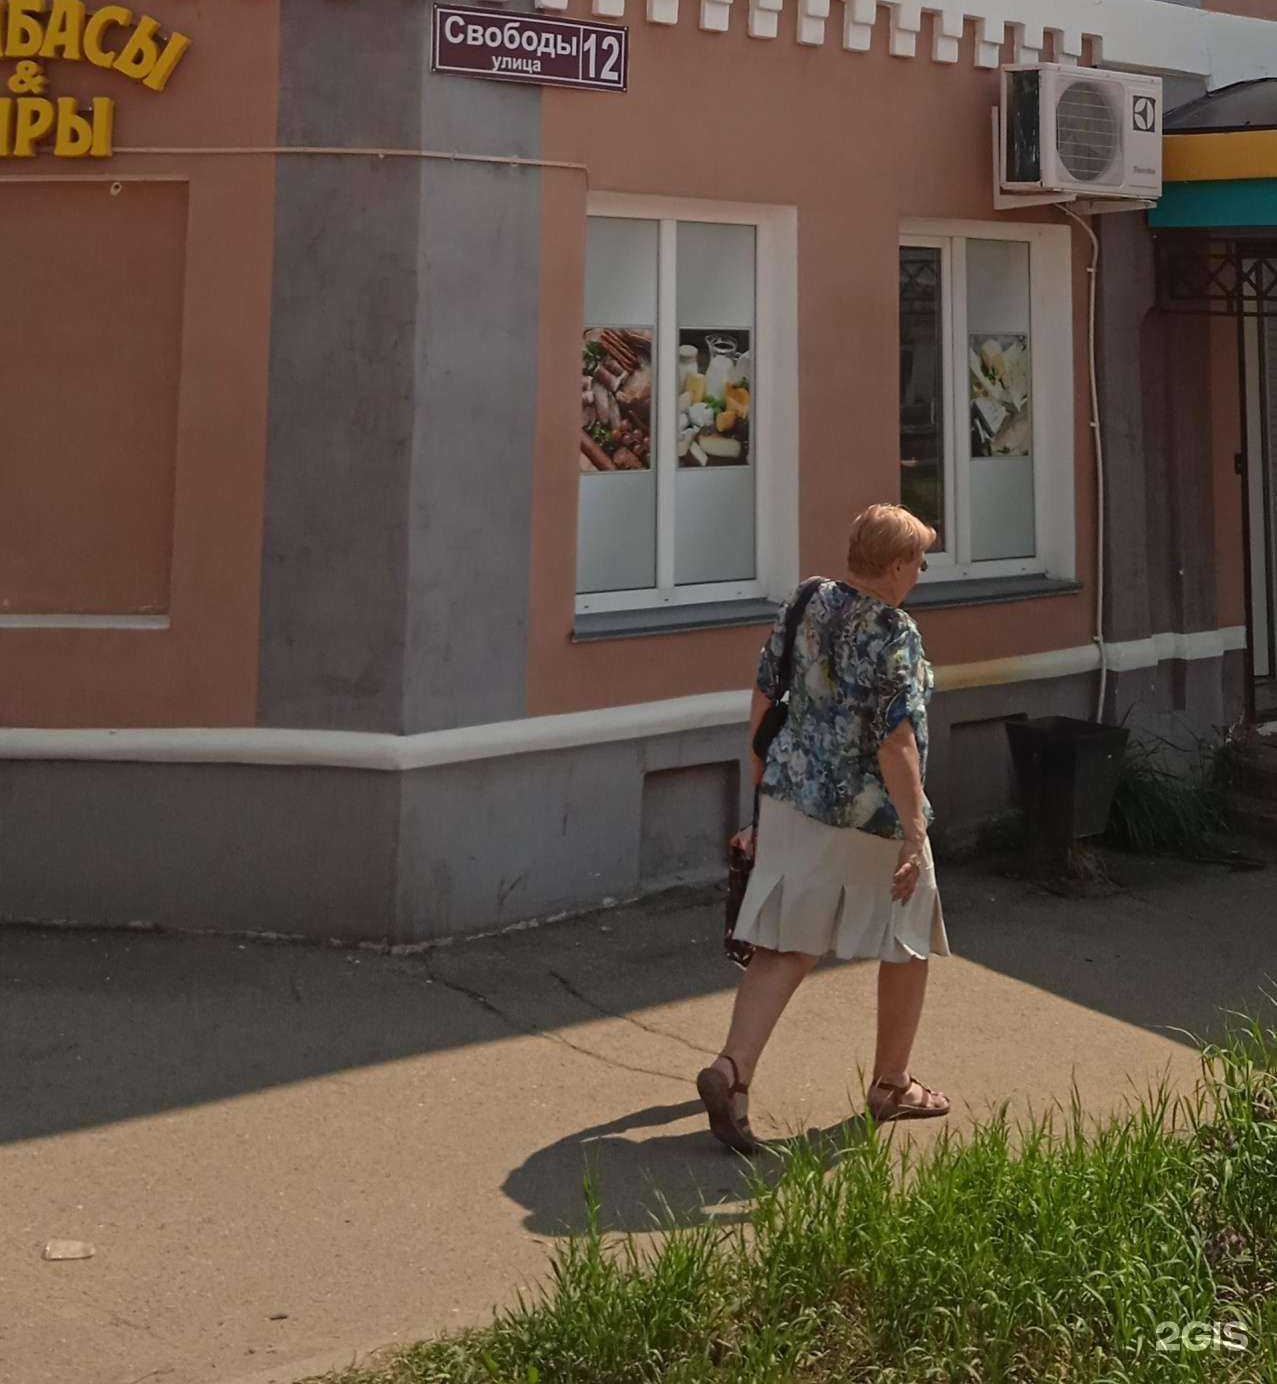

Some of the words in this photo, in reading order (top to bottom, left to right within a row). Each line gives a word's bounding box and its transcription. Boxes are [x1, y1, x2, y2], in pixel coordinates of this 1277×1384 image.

[444, 14, 578, 58] Свободы
[583, 32, 621, 81] 12
[491, 54, 542, 73] улица
